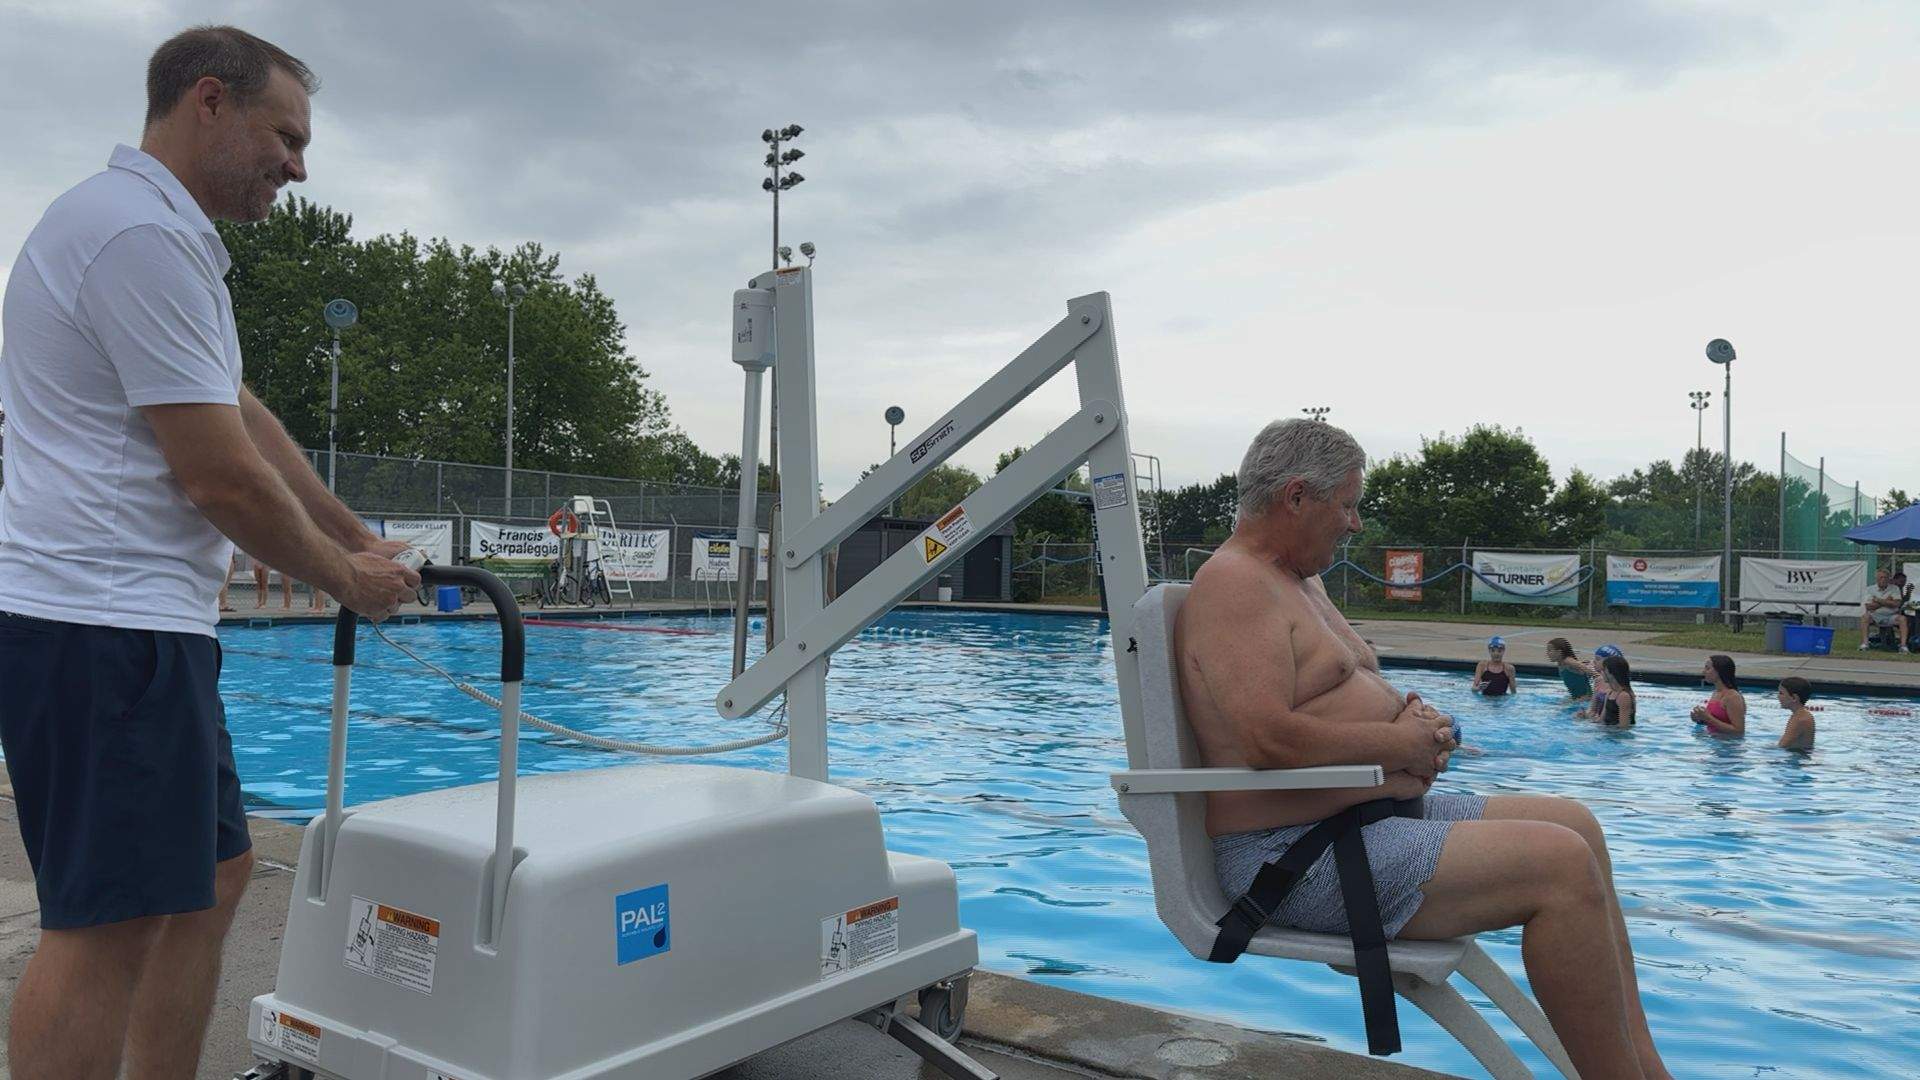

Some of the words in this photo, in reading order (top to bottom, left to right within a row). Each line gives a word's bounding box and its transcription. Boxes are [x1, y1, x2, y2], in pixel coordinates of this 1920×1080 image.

[498, 528, 543, 541] Francis
[480, 539, 558, 557] Scarpaleggia
[1497, 573, 1544, 585] TURNER
[1787, 570, 1817, 583] BW
[393, 912, 430, 932] WARNING
[385, 923, 406, 936] TIPPING
[406, 930, 430, 943] HAZARD
